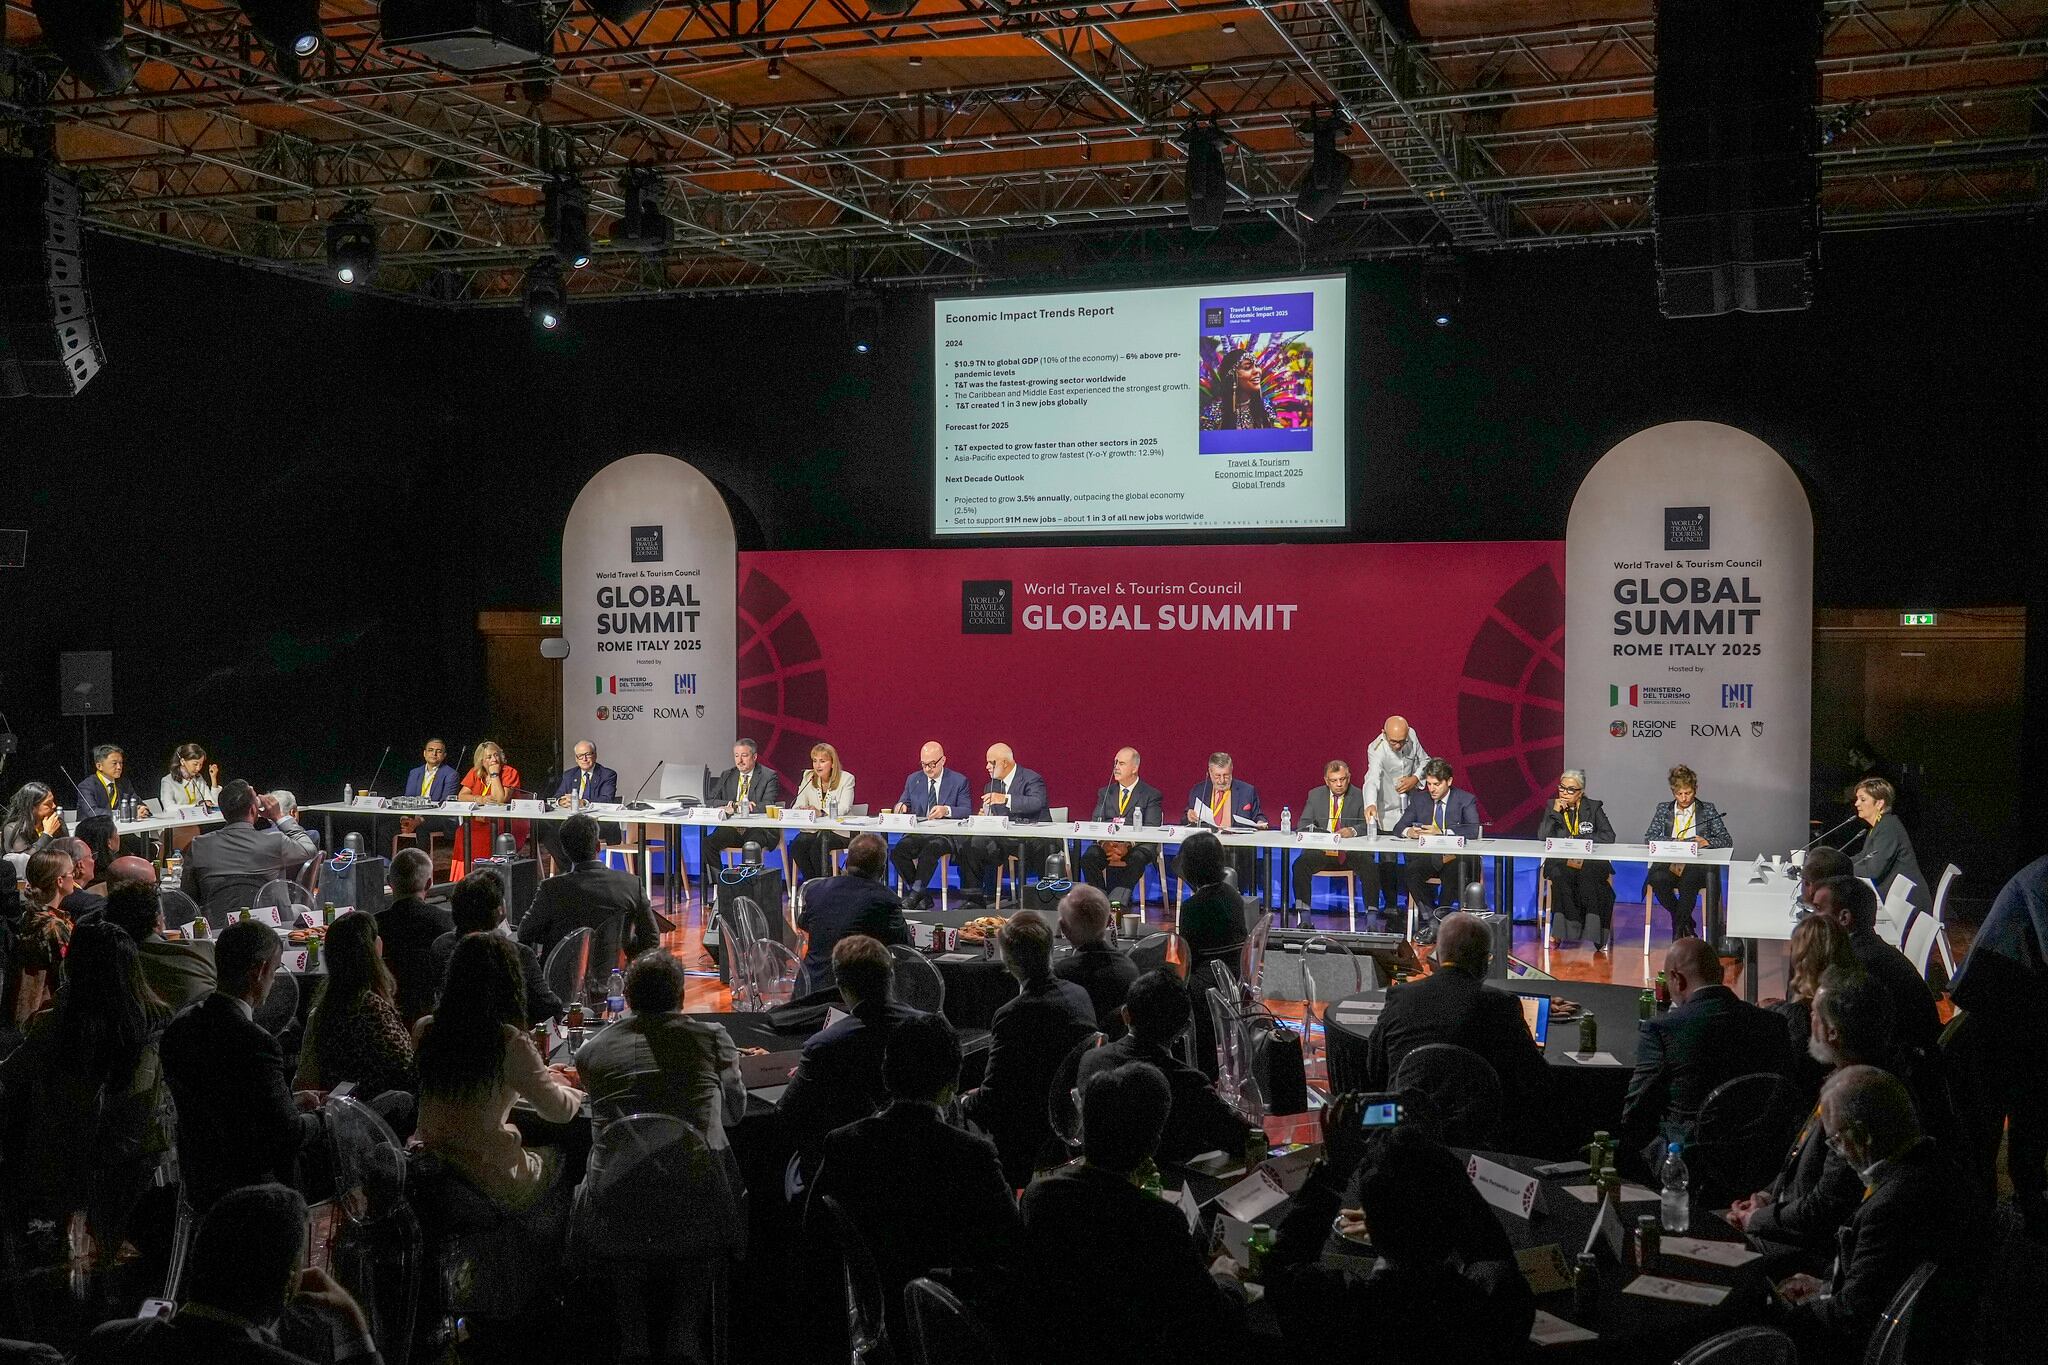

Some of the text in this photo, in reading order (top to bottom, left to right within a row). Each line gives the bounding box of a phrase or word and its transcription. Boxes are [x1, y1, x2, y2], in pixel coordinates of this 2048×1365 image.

[946, 307, 1114, 323] Economic Impact Trends Report
[954, 360, 975, 368] $10.9
[997, 358, 1020, 367] global
[1040, 357, 1058, 365] (10%
[955, 370, 992, 379] pandemic
[1000, 378, 1058, 387] fastest-growing
[1086, 375, 1126, 383] worldwide
[969, 391, 1006, 399] Caribbean
[1066, 387, 1111, 395] experienced
[1127, 385, 1161, 393] strongest
[1163, 384, 1190, 392] growth.
[1039, 400, 1055, 408] jobs
[1057, 398, 1087, 407] globally
[969, 443, 1003, 452] expected
[954, 454, 995, 462] Asia-Pacific
[998, 453, 1031, 461] expected
[1086, 451, 1107, 459] (Y-o-Y
[1109, 450, 1136, 458] growth:
[1139, 449, 1164, 457] 12.9%)
[1228, 459, 1249, 467] Travel
[1260, 458, 1289, 466] Tourism
[1255, 470, 1282, 478] Impact
[1260, 480, 1285, 488] Trends
[955, 496, 988, 505] Projected
[1074, 493, 1110, 502] outpacing
[1126, 493, 1148, 501] global
[954, 507, 977, 515] (2.5%)
[1040, 516, 1056, 524] jobs
[1146, 514, 1163, 522] jobs
[1614, 561, 1642, 570] World
[1644, 561, 1673, 569] Travel
[1686, 560, 1723, 568] Tourism
[1726, 560, 1762, 568] Council
[675, 569, 700, 577] Council
[1025, 582, 1242, 595] World Travel & Tourism Council
[1614, 577, 1760, 605] GLOBAL
[597, 584, 700, 608] GLOBAL
[598, 611, 700, 634] SUMMIT
[1022, 604, 1297, 631] GLOBAL SUMMIT
[1614, 610, 1760, 636] SUMMIT
[598, 640, 701, 652] ROME ITALY 2025
[1614, 644, 1761, 656] ROME ITALY 2025
[675, 674, 696, 694] ENIT
[1722, 684, 1753, 708] ENIT
[654, 708, 689, 718] ROMA
[1632, 720, 1676, 728] REGIONE
[1691, 724, 1741, 737] ROMA
